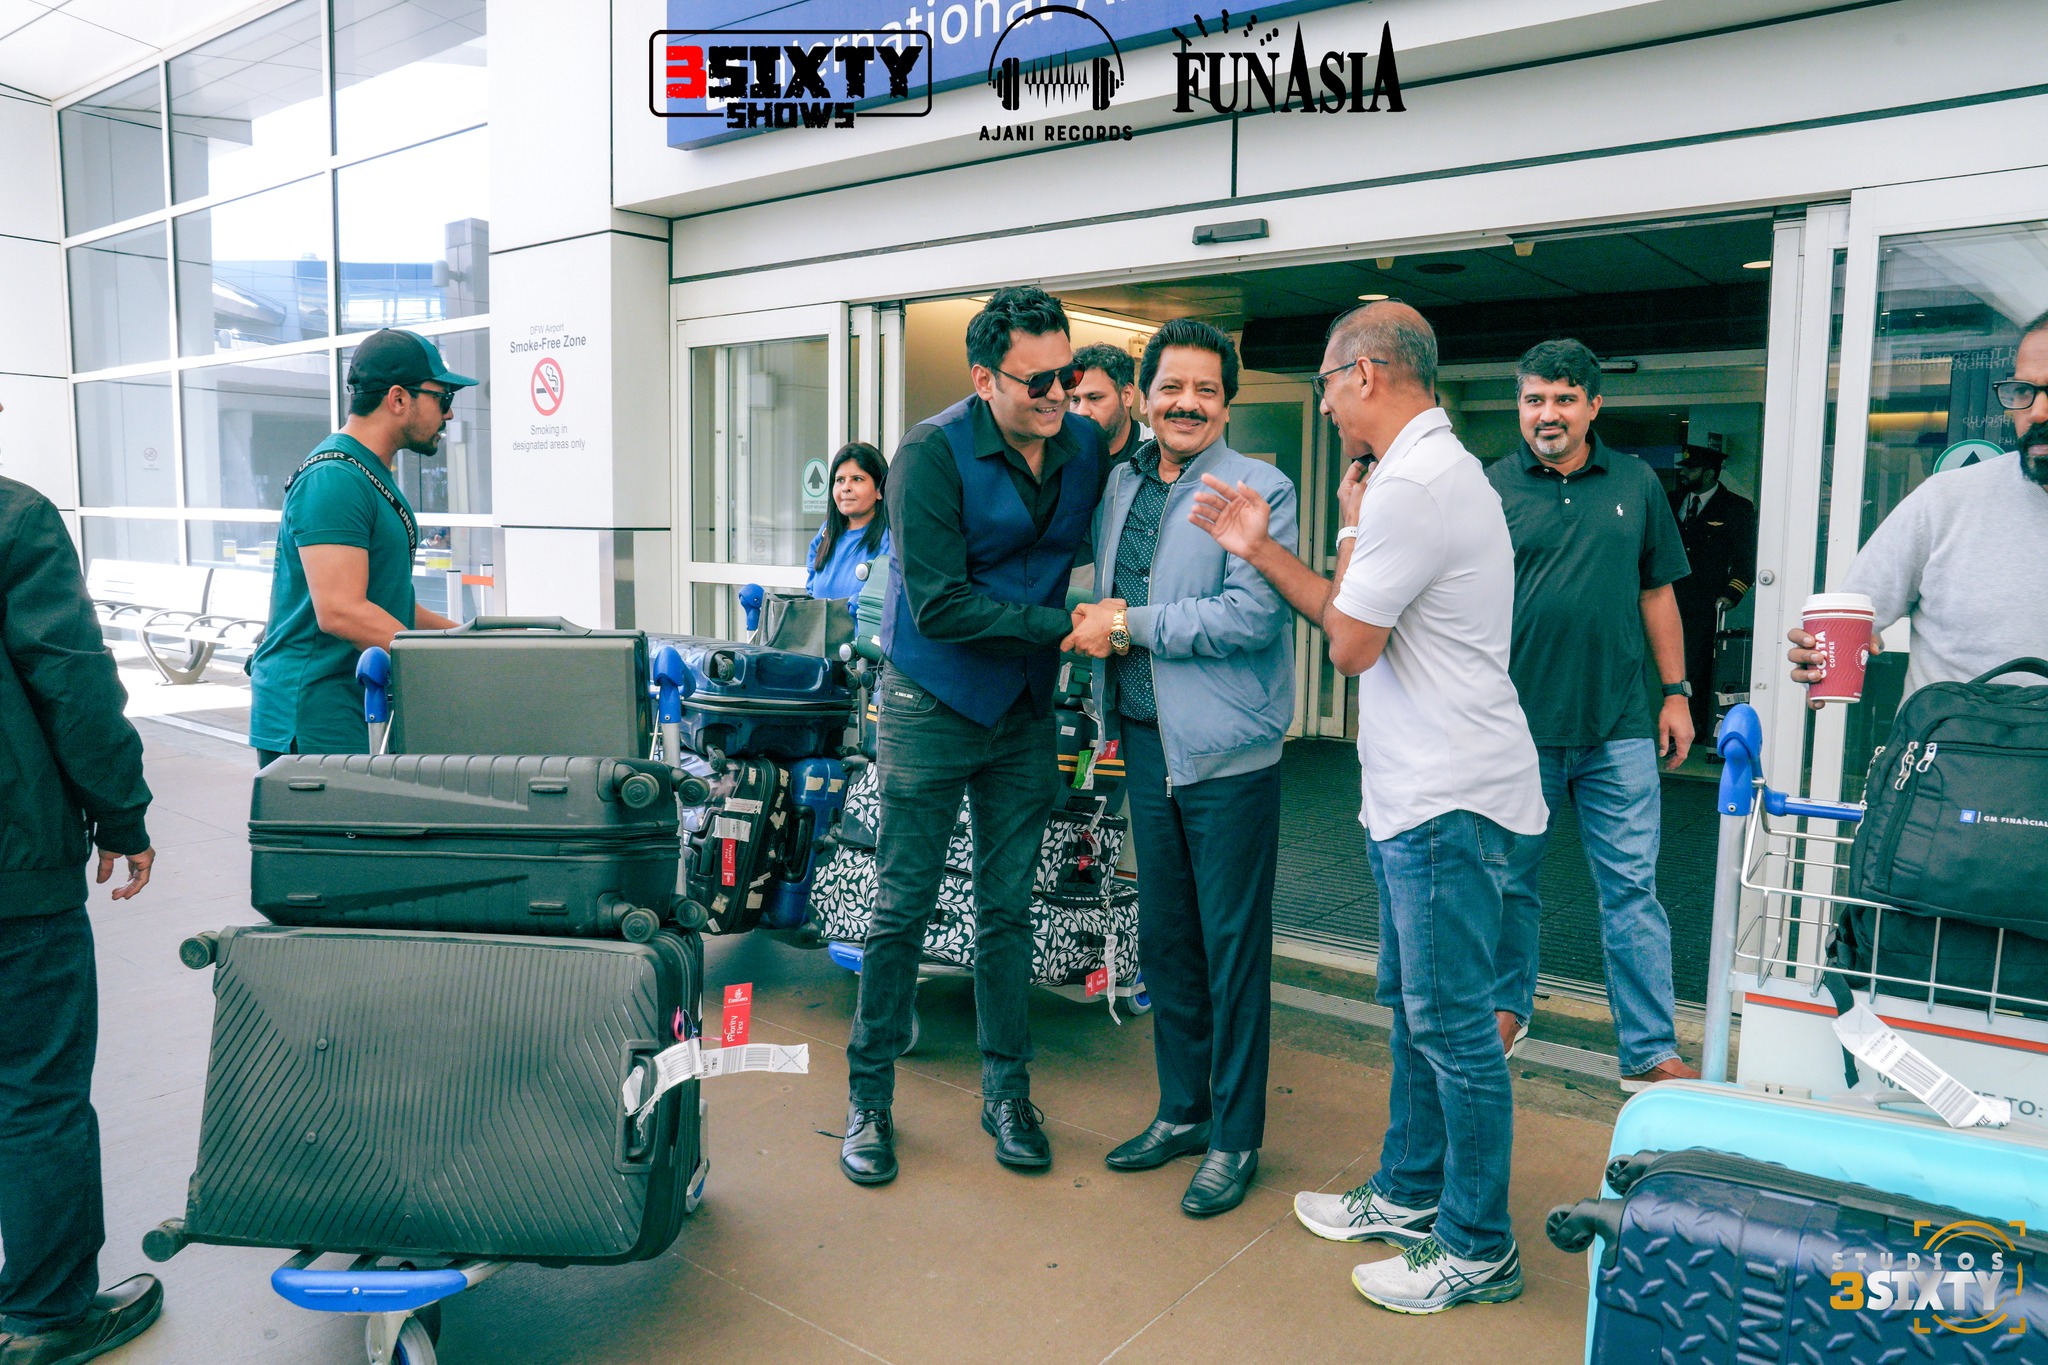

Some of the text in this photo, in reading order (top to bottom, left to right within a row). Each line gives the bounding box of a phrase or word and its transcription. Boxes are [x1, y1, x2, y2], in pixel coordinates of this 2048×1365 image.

[753, 0, 1053, 88] nernationa
[530, 323, 565, 335] DFW Airport
[510, 335, 587, 353] Smoke-Free Zone
[530, 424, 568, 437] Smoking in
[512, 438, 586, 453] designated areas only
[298, 452, 417, 547] UNDER ARMOUR UNDER
[1983, 815, 1998, 823] GM
[2000, 817, 2048, 828] FINANCIAL
[1736, 1259, 1787, 1365] TIM
